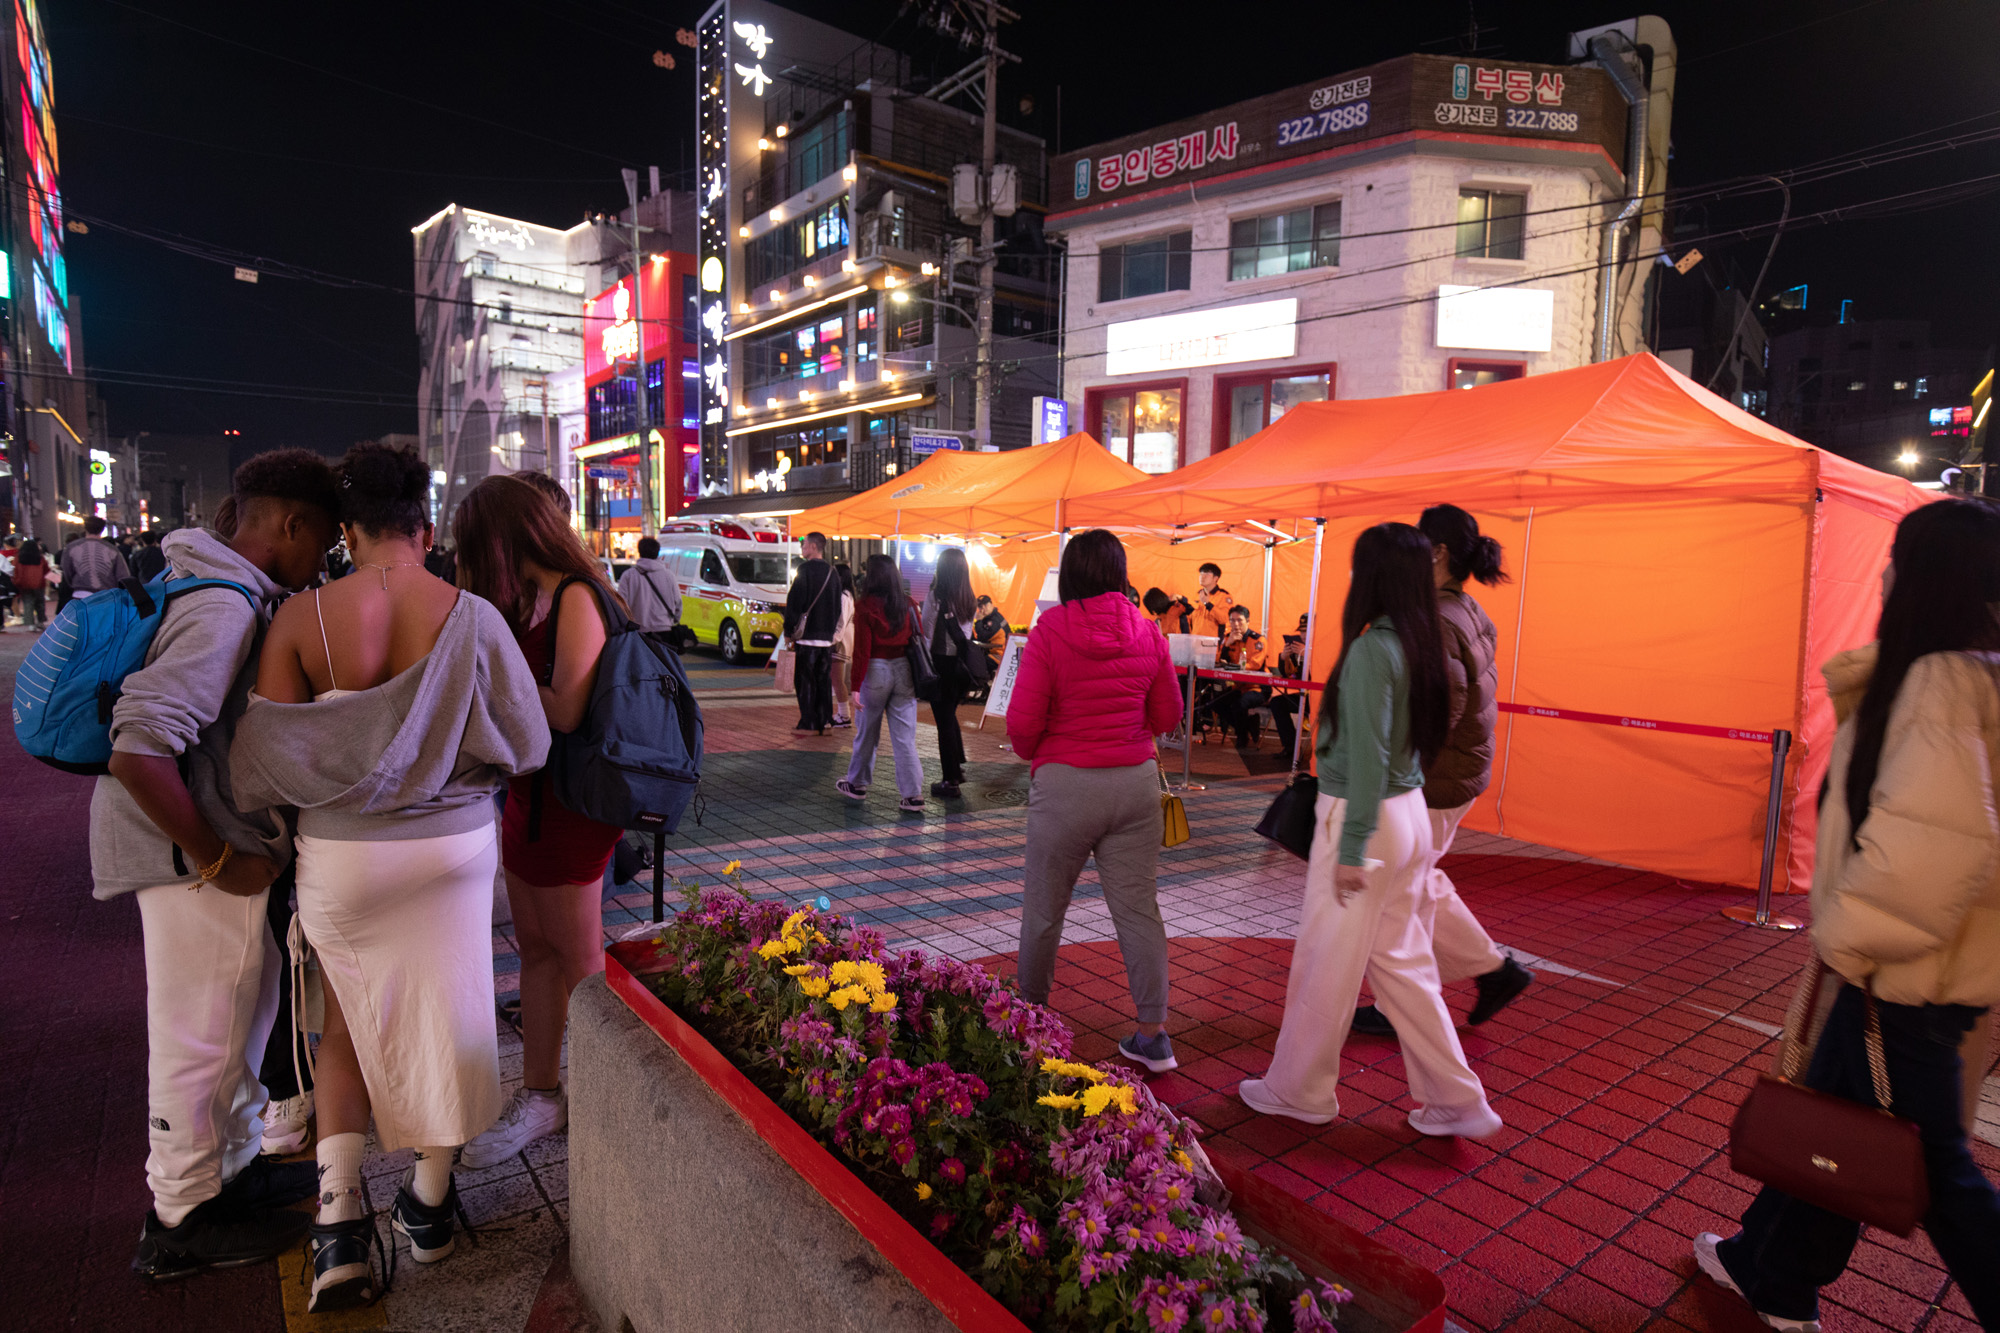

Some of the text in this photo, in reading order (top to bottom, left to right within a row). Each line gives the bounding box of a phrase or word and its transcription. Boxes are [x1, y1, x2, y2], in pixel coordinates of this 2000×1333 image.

[1309, 76, 1372, 110] 상가전문
[1455, 67, 1565, 106] 에이스 부동산
[1277, 102, 1369, 146] 322.7888
[1434, 103, 1578, 132] 상가전문 322.7888
[1078, 162, 1088, 196] 에이스
[1097, 121, 1241, 192] 공인중개사
